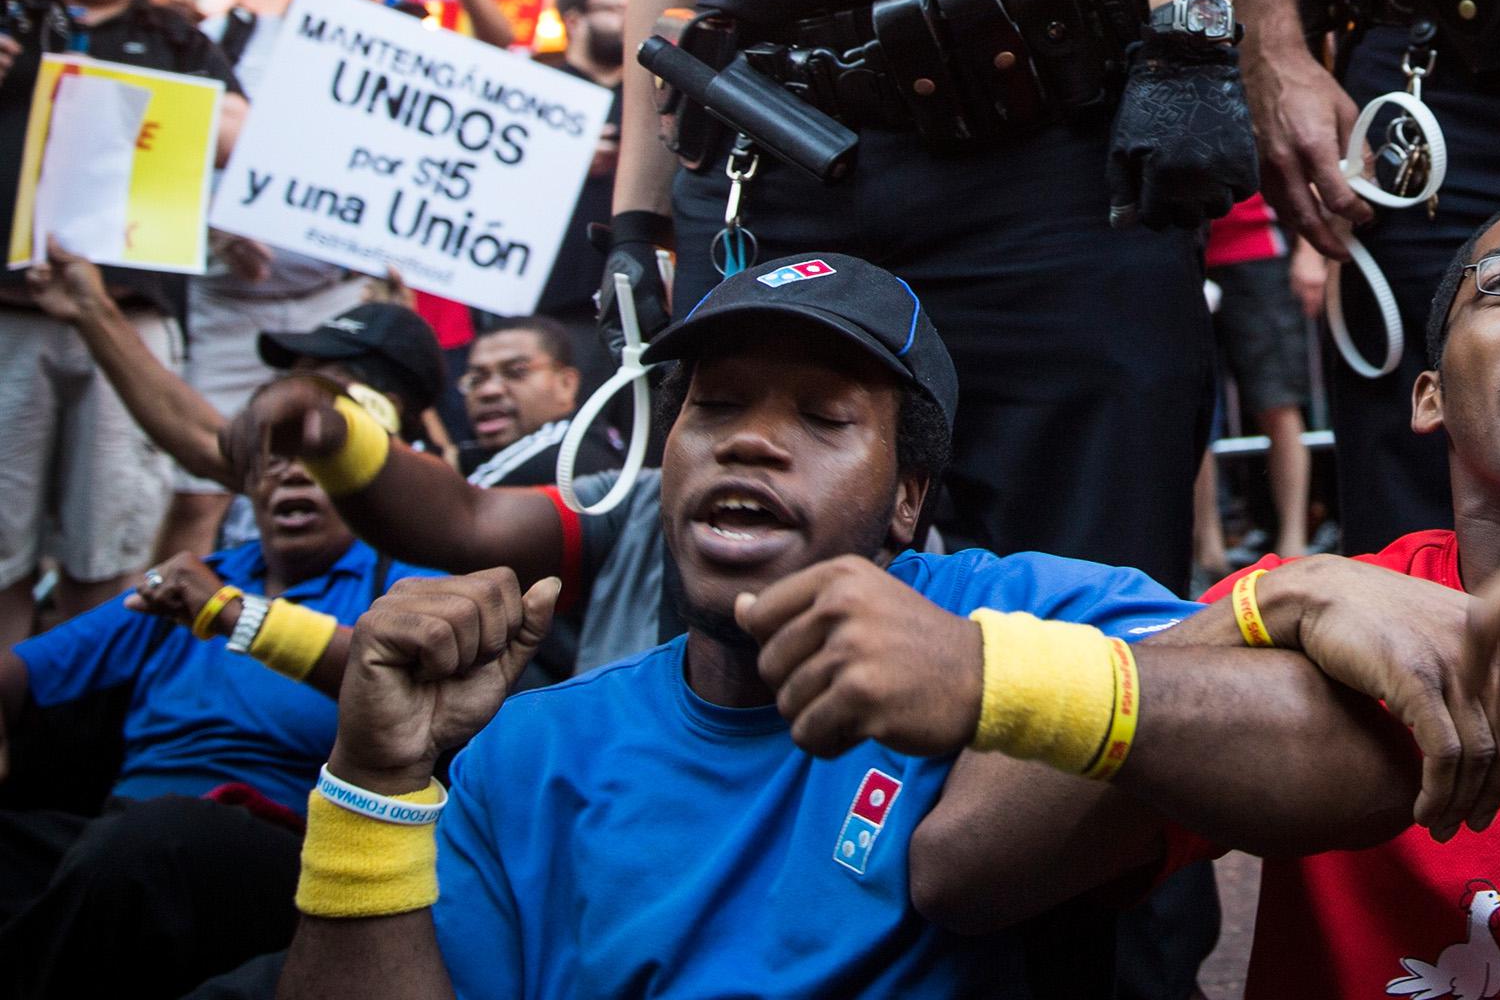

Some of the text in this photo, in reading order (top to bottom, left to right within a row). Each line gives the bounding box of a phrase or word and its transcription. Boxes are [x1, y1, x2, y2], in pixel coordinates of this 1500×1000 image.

[330, 59, 531, 167] UNIDOS
[347, 146, 404, 178] por
[241, 168, 532, 278] y una Unión
[322, 780, 388, 816] FORWARD
[390, 806, 428, 822] FOOD
